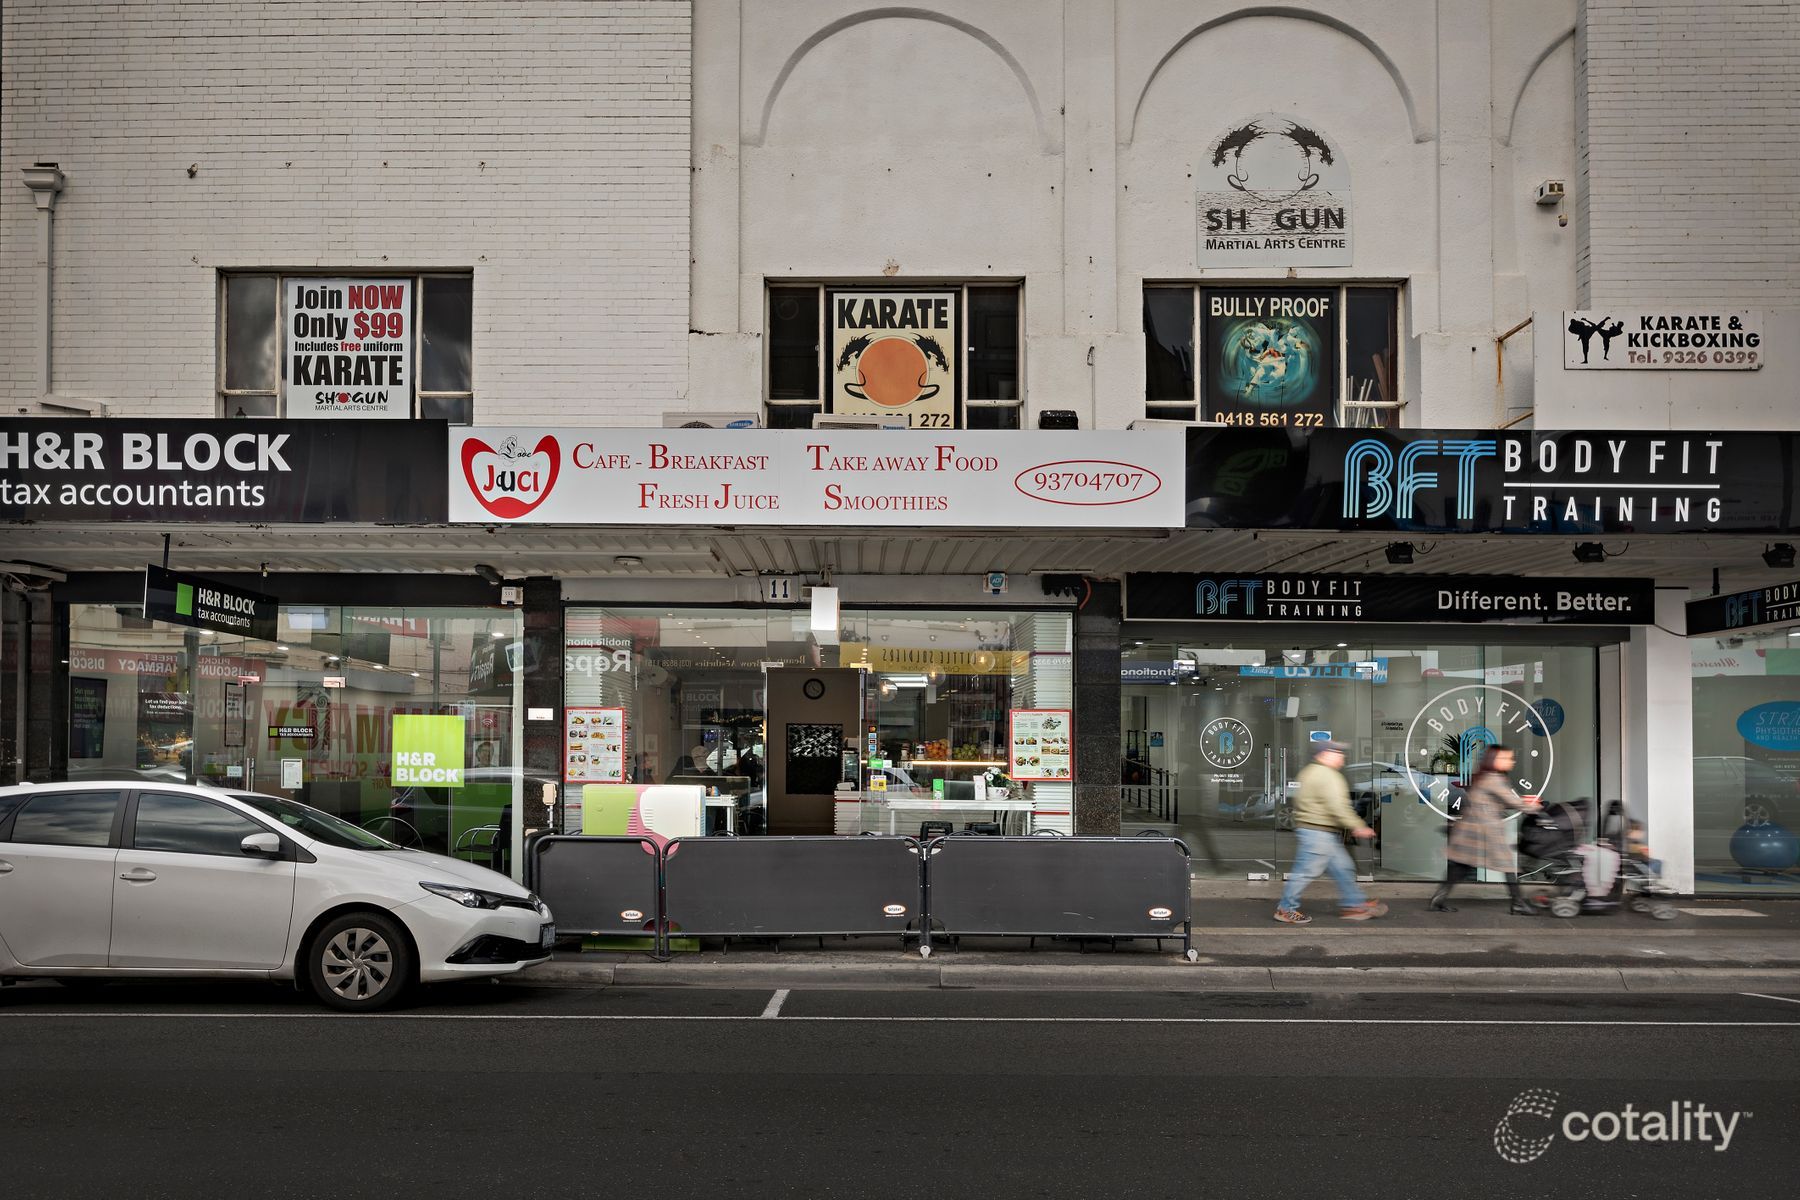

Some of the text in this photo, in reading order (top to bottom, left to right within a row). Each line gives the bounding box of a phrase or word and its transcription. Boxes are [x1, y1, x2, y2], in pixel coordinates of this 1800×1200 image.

[1206, 238, 1345, 249] MARTIAL ARTS CENTRE
[295, 285, 404, 310] Join NOW
[1211, 297, 1330, 317] BULLY PROOF
[838, 299, 948, 329] KARATE
[1640, 316, 1743, 331] KARATE &
[294, 311, 403, 340] Only $99
[295, 342, 402, 351] Includes free uniform
[1628, 333, 1760, 348] KICKBOXING
[1628, 351, 1758, 364] Tel. 9326 0399
[293, 355, 403, 386] KARATE
[920, 413, 950, 427] 272
[1215, 412, 1324, 426] 0418 561 272
[0, 432, 292, 471] H&R BLOCK
[572, 443, 631, 470] CAFE
[648, 443, 769, 471] BREAKFAST
[806, 445, 998, 472] TAKE AWAY FOOD
[1504, 440, 1723, 475] BODY FIT
[1034, 472, 1143, 492] 93704707
[1343, 438, 1497, 520] BFT
[0, 479, 265, 507] tax accountants
[638, 483, 779, 510] FRESH JUICE
[824, 484, 948, 511] SMOOTHIES
[1503, 496, 1721, 523] TRAINING
[771, 579, 788, 598] 11
[1196, 579, 1263, 615] BFT
[1267, 580, 1362, 596] BODY FIT
[1765, 584, 1798, 603] BODY
[198, 587, 256, 616] H&R BLOCK
[1267, 604, 1362, 617] TRAINING
[1438, 590, 1632, 612] Different. Better.
[198, 608, 250, 628] tax accountants
[1427, 696, 1533, 733] BODY FIT
[1208, 721, 1246, 736] BODY FIT
[396, 752, 436, 766] H&R
[1207, 750, 1246, 765] TRAINING
[396, 768, 459, 783] BLOCK
